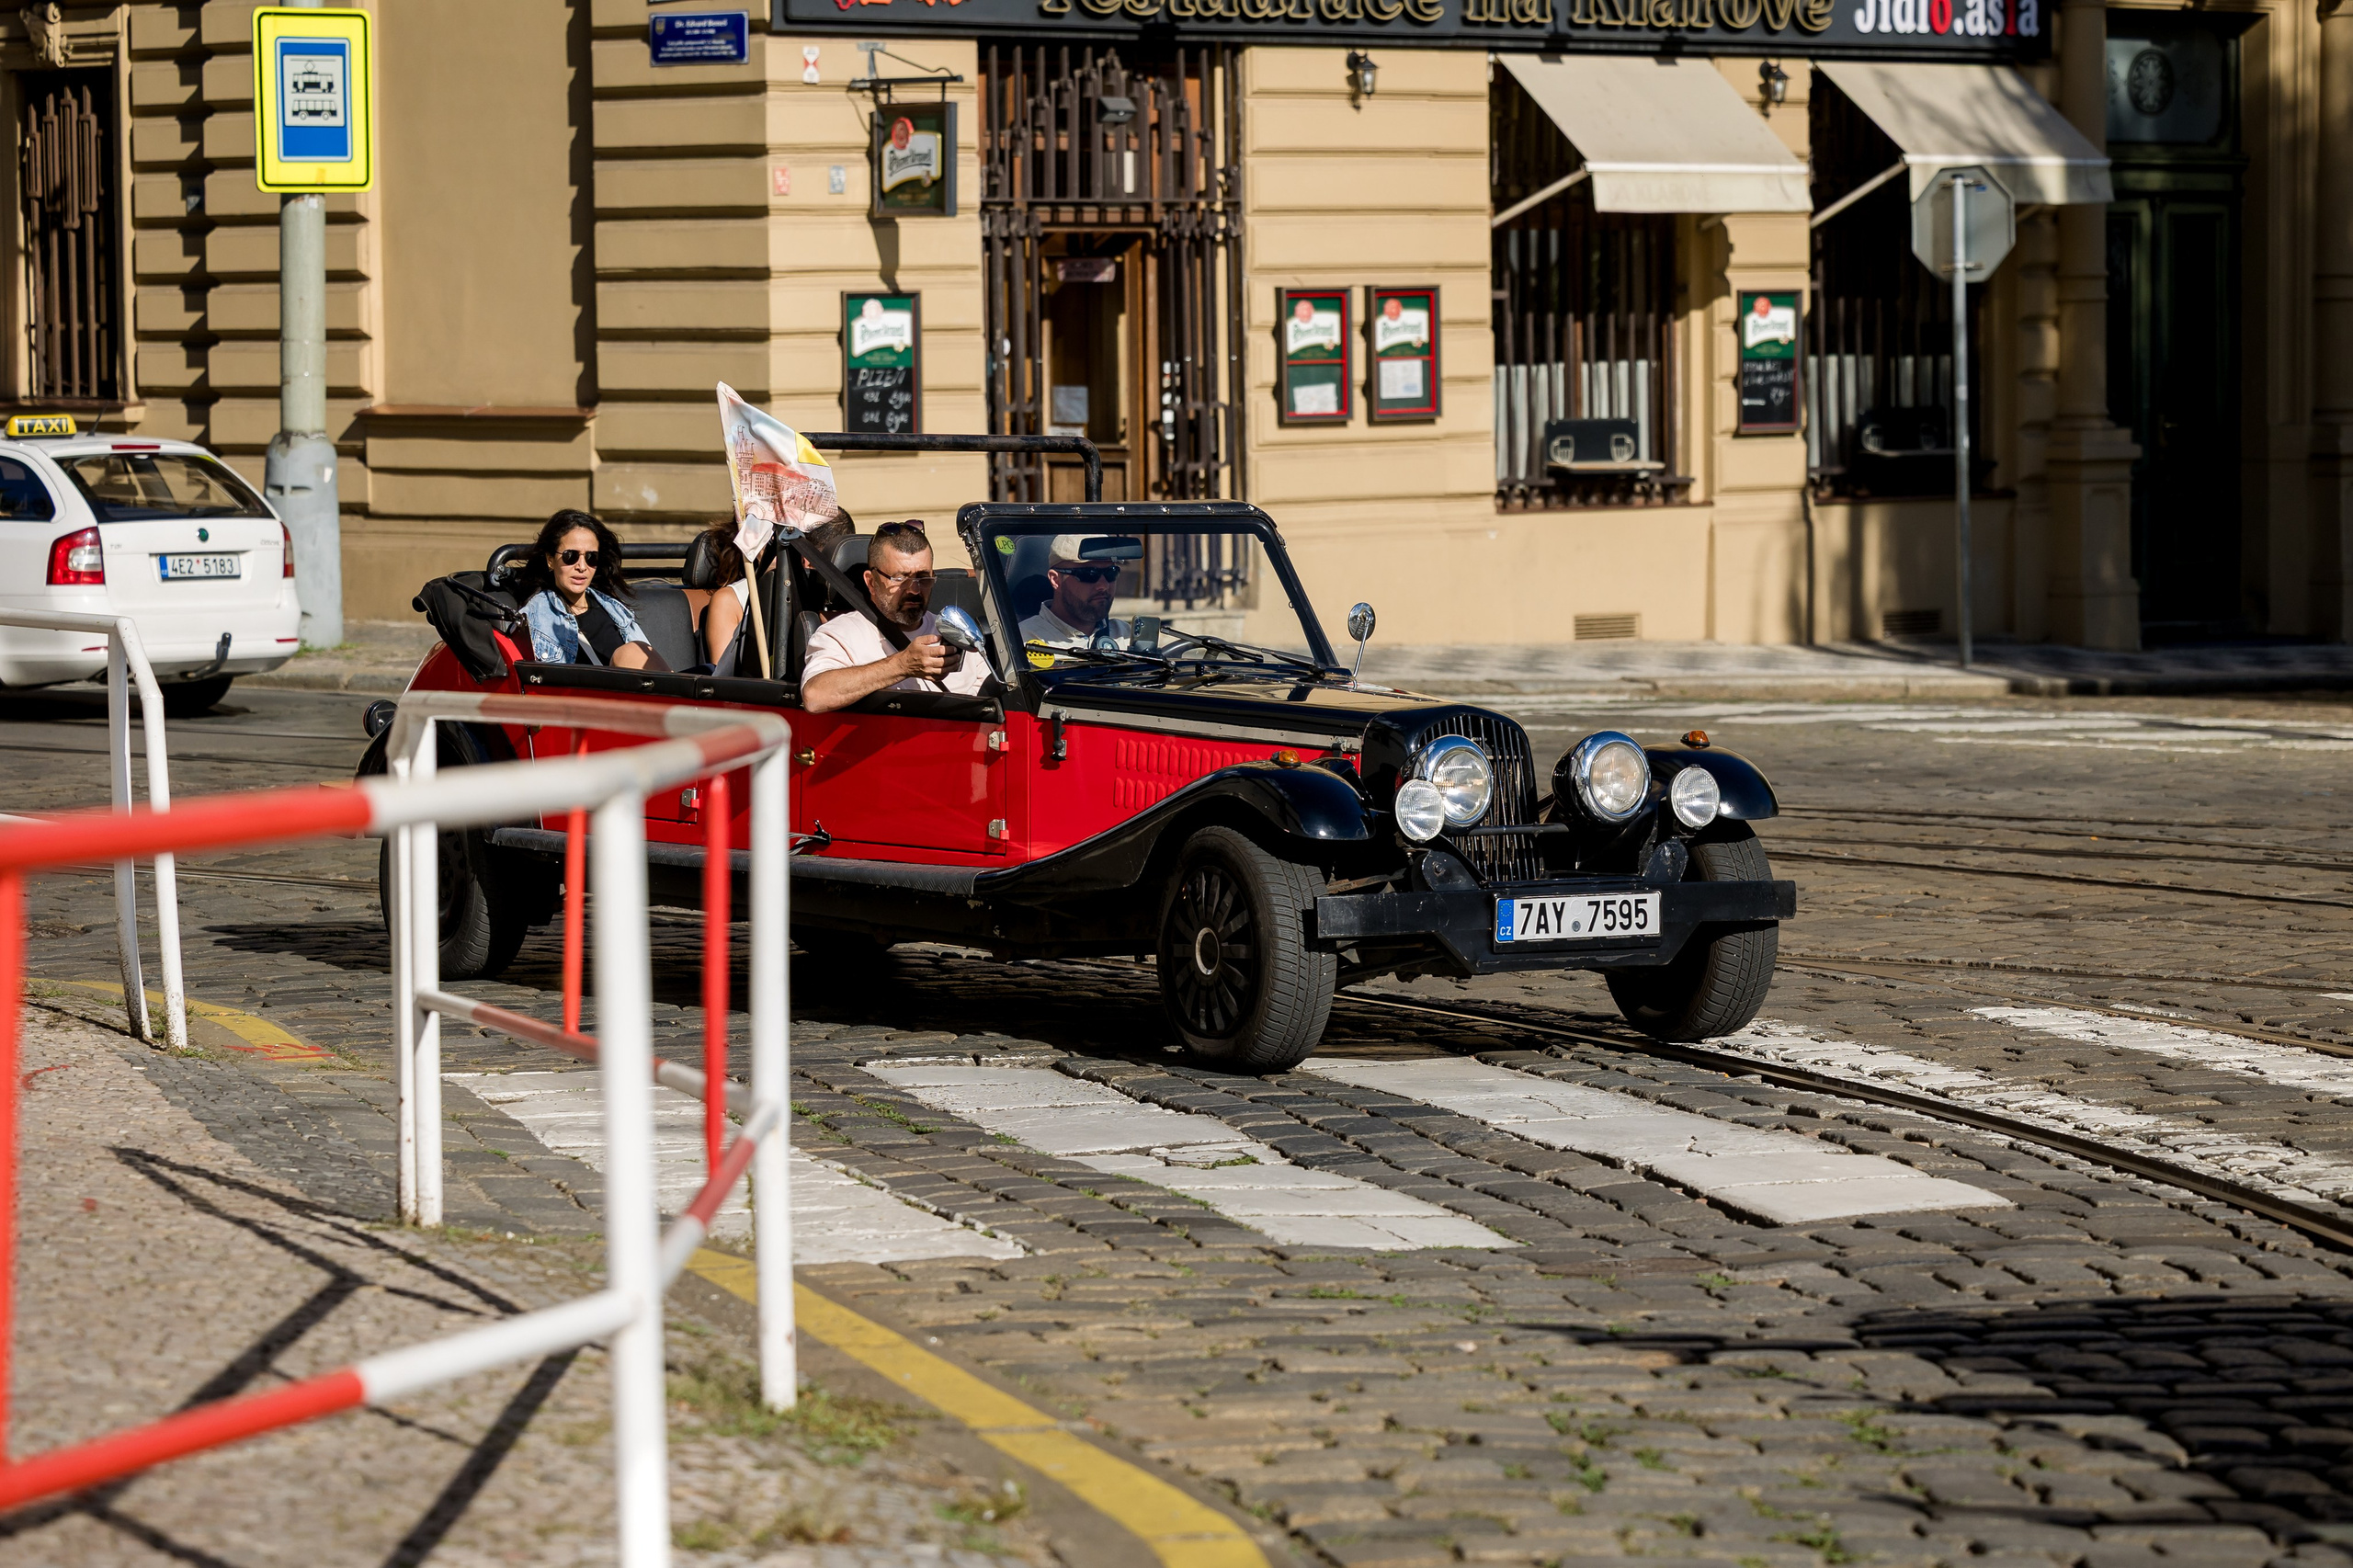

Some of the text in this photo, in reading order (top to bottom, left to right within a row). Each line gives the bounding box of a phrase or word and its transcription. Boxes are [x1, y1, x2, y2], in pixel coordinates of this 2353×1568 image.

[22, 417, 69, 434] TAXI
[997, 539, 1014, 550] LPG
[172, 559, 194, 575] 4E2
[203, 558, 234, 575] 5183
[1499, 898, 1648, 936] CZ 7AY 7595
